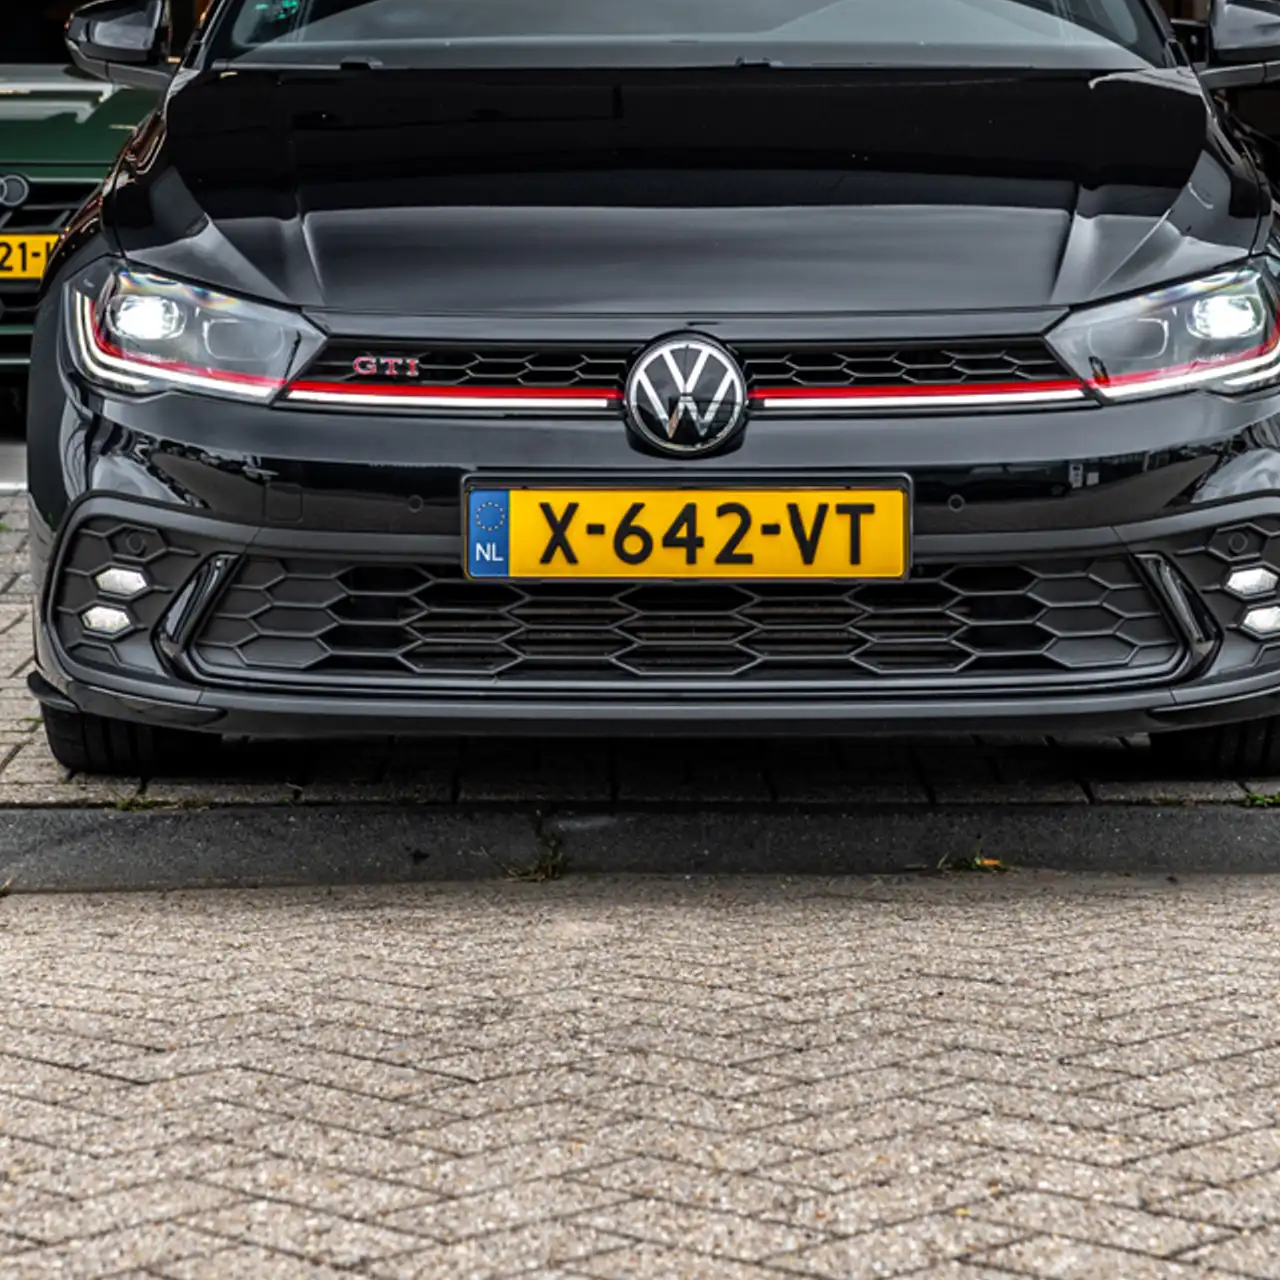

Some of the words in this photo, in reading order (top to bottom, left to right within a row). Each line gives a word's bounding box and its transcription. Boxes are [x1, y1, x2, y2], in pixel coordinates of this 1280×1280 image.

[353, 356, 420, 376] GTI
[539, 503, 875, 565] X-642-VT
[476, 543, 503, 562] NL
